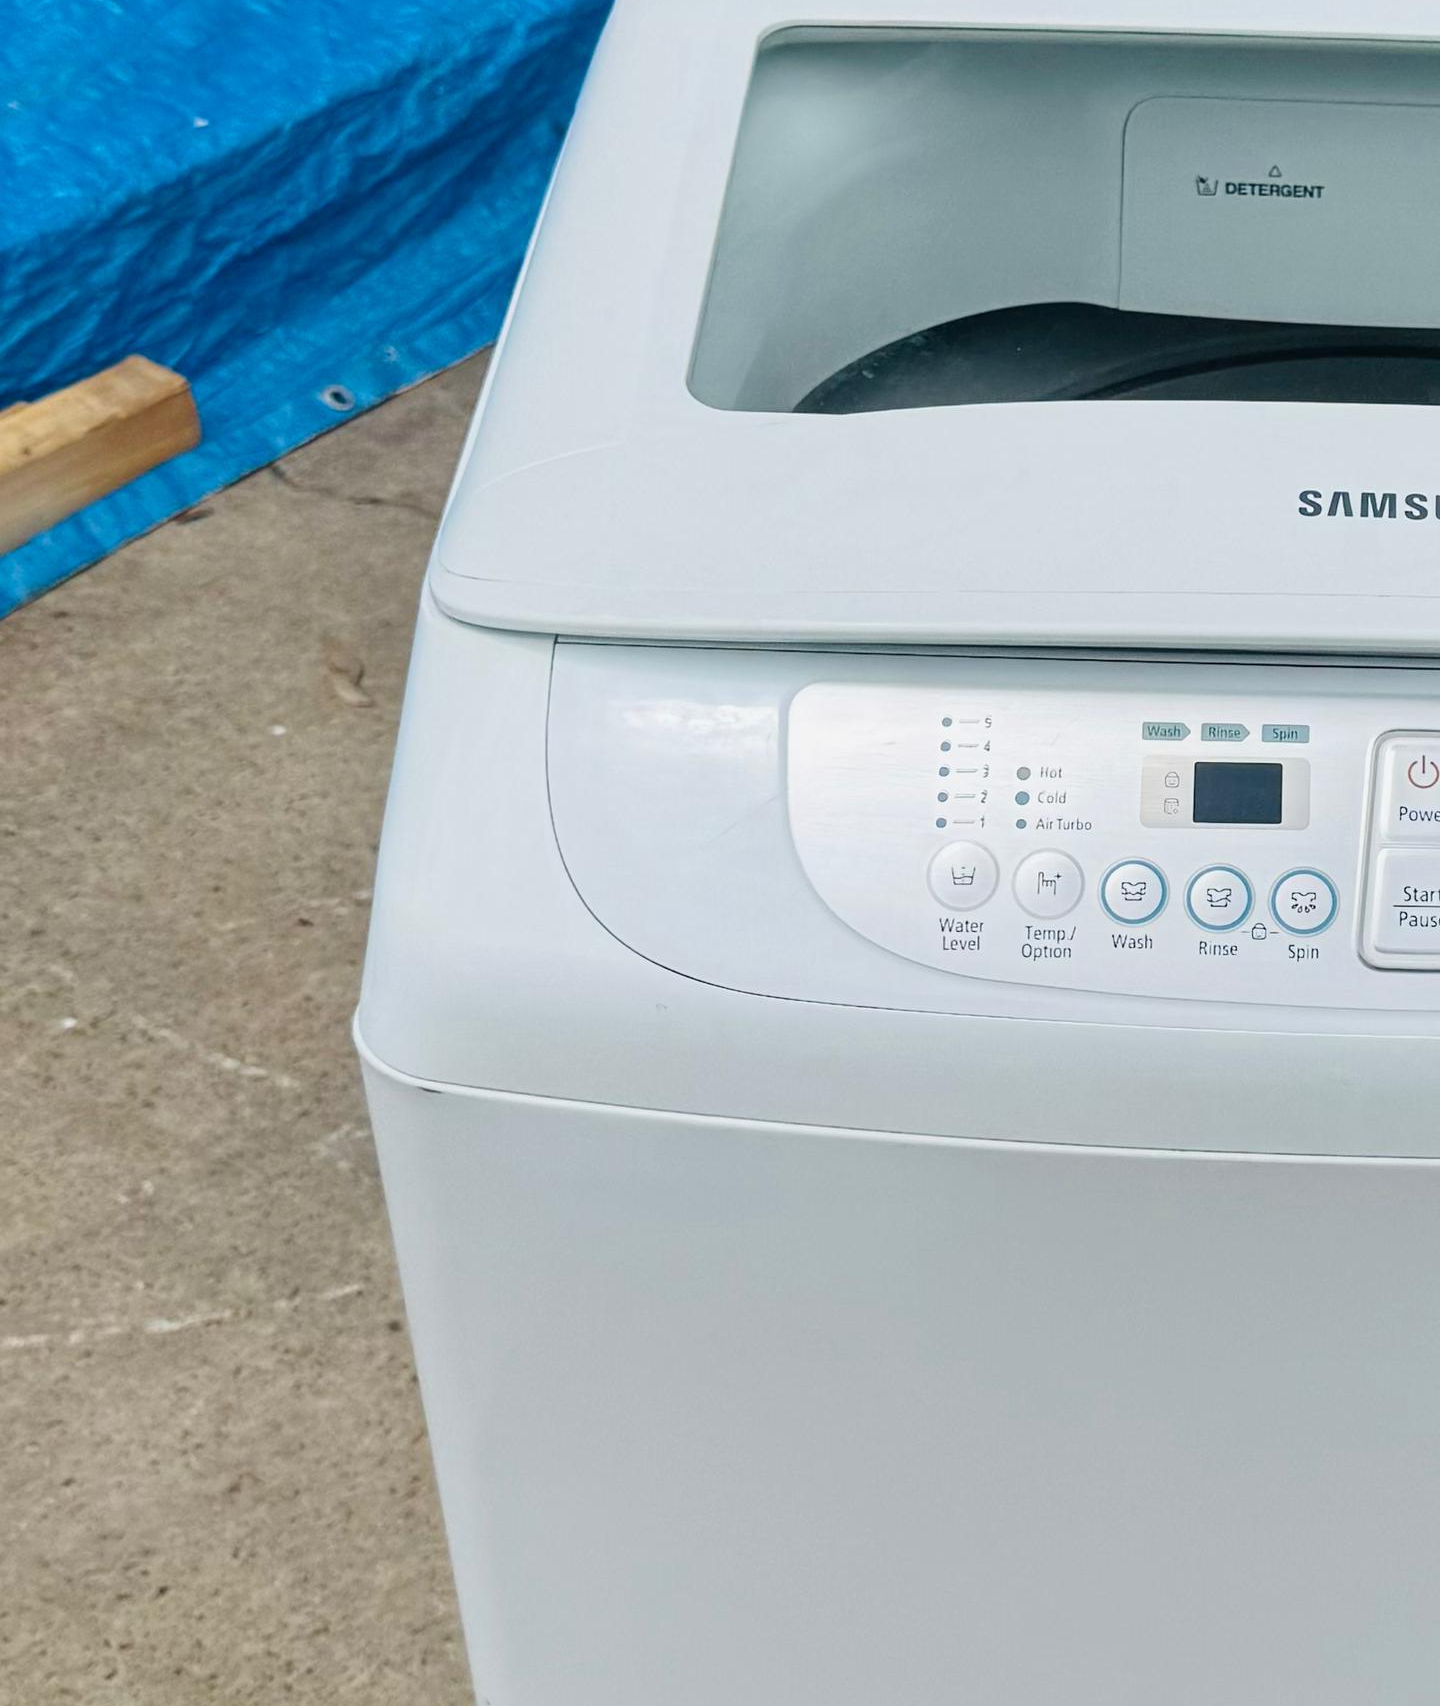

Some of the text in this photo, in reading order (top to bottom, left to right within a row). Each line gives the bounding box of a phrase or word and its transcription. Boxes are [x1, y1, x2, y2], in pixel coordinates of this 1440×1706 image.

[1224, 181, 1325, 199] DETERGENT
[1147, 725, 1181, 737] Wash
[1208, 726, 1241, 739] Rinse
[1272, 726, 1299, 742] Spin
[1039, 765, 1064, 780] Hot
[1037, 791, 1067, 804] Cold
[1034, 817, 1093, 831] Air Turbo
[938, 917, 986, 935] Water
[1024, 925, 1077, 944] Temp./
[1111, 933, 1153, 950] Wash
[941, 935, 982, 952] Level
[1199, 940, 1238, 956] Rinse
[1020, 943, 1073, 962] Option
[1288, 944, 1319, 963] Spin
